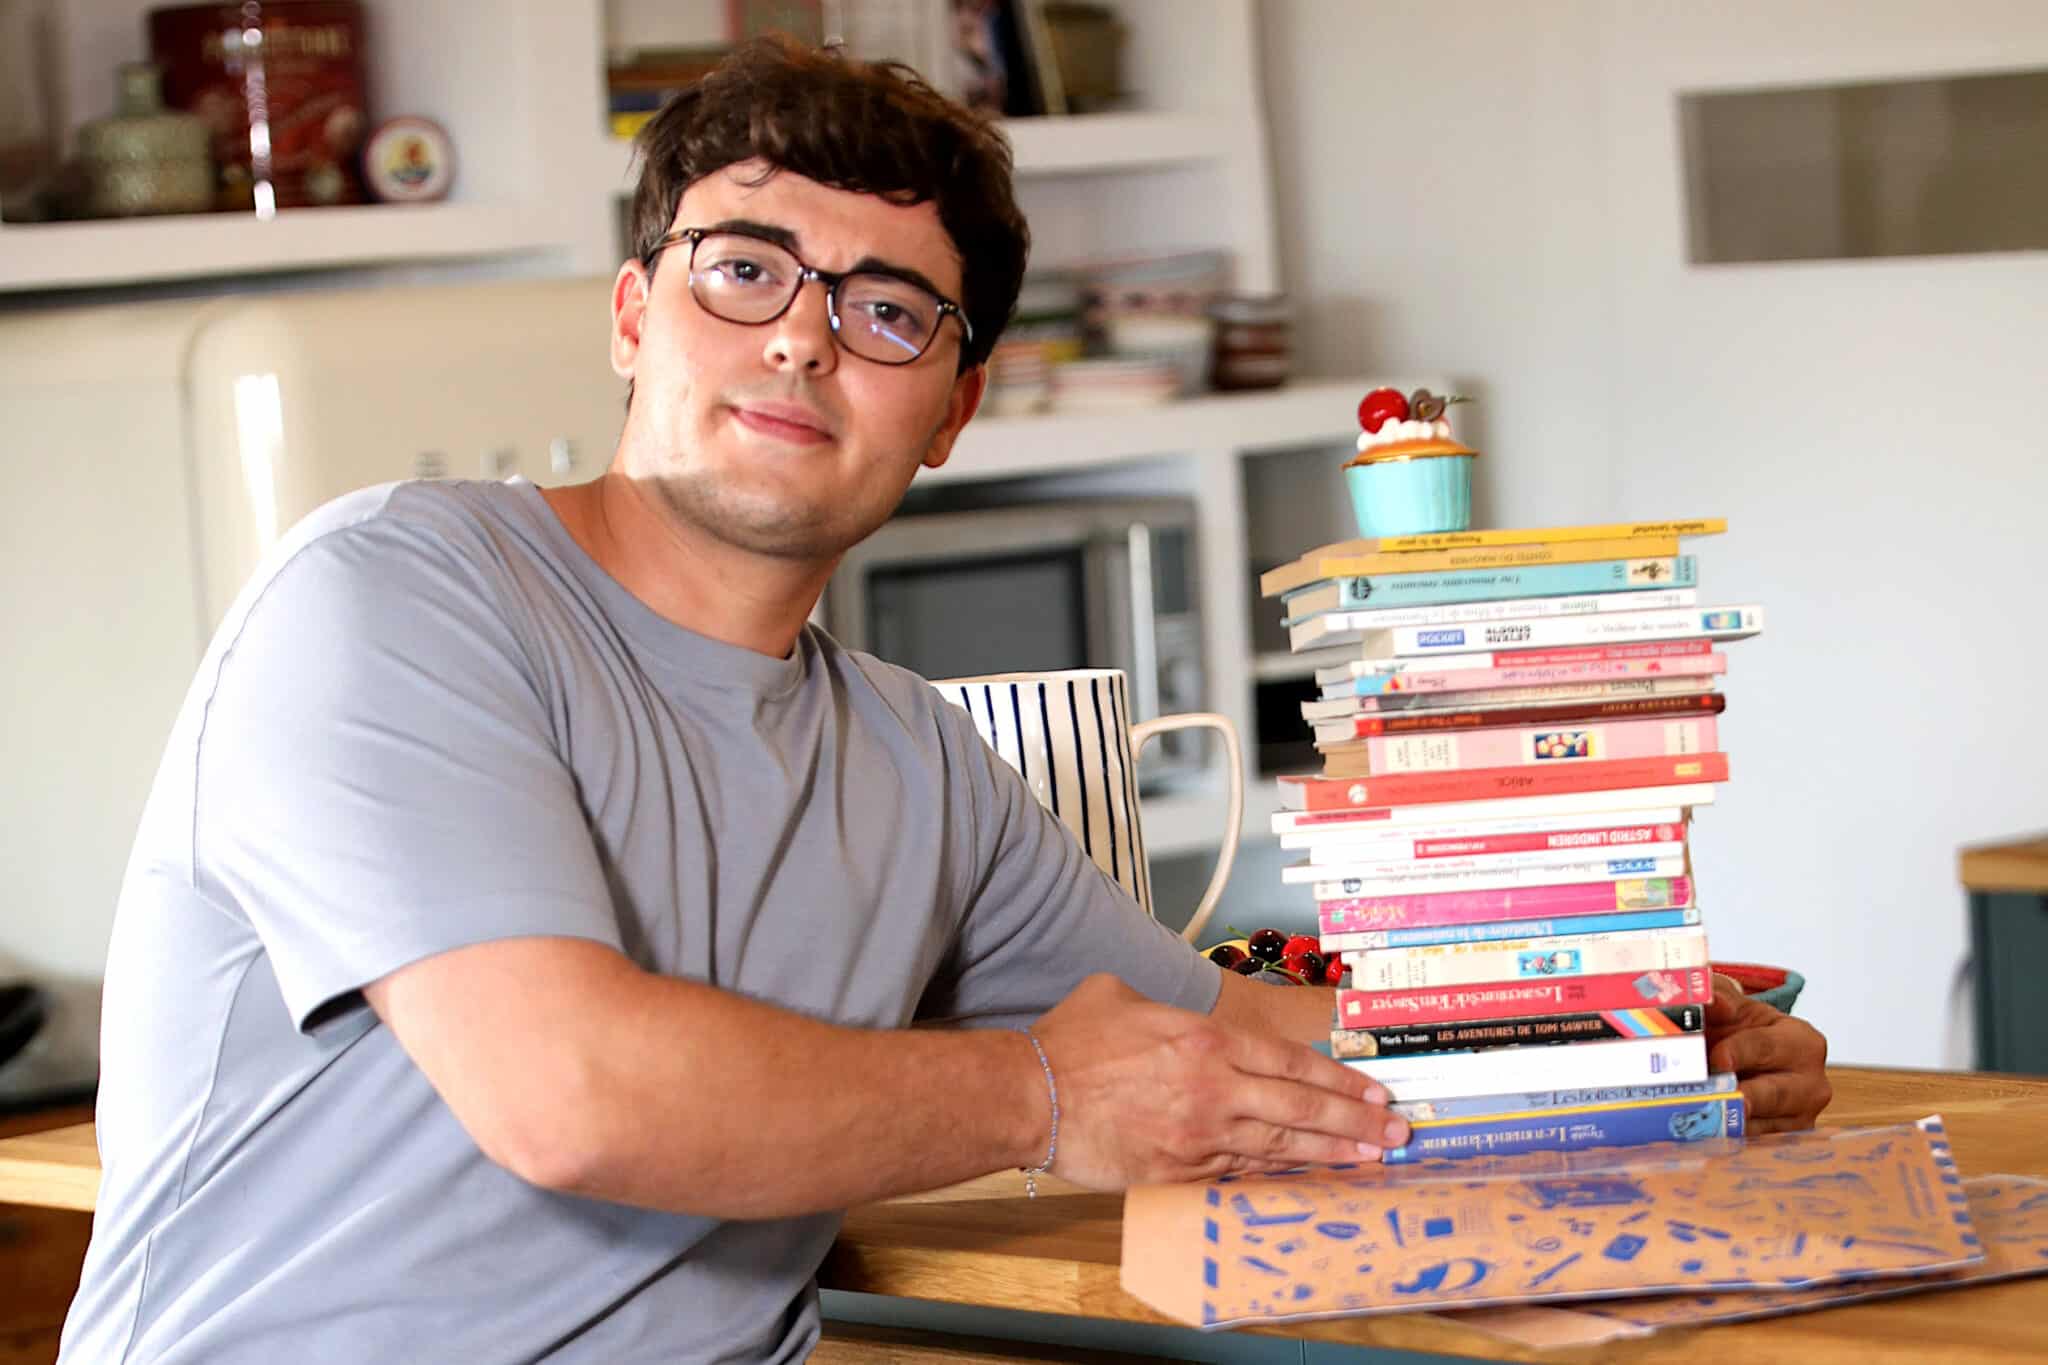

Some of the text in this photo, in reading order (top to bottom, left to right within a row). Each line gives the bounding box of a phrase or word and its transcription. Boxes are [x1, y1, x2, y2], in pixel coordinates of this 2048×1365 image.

[1547, 829, 1653, 848] ASTRID LINDGREN
[1371, 993, 1420, 1012] Sawyer
[1422, 993, 1452, 1010] Tom
[1472, 988, 1536, 1006] aventures
[1536, 986, 1562, 1004] Les
[1437, 1019, 1603, 1042] LES AVENTURES DE TOM SAWYER
[1380, 1034, 1430, 1046] Mark Twain
